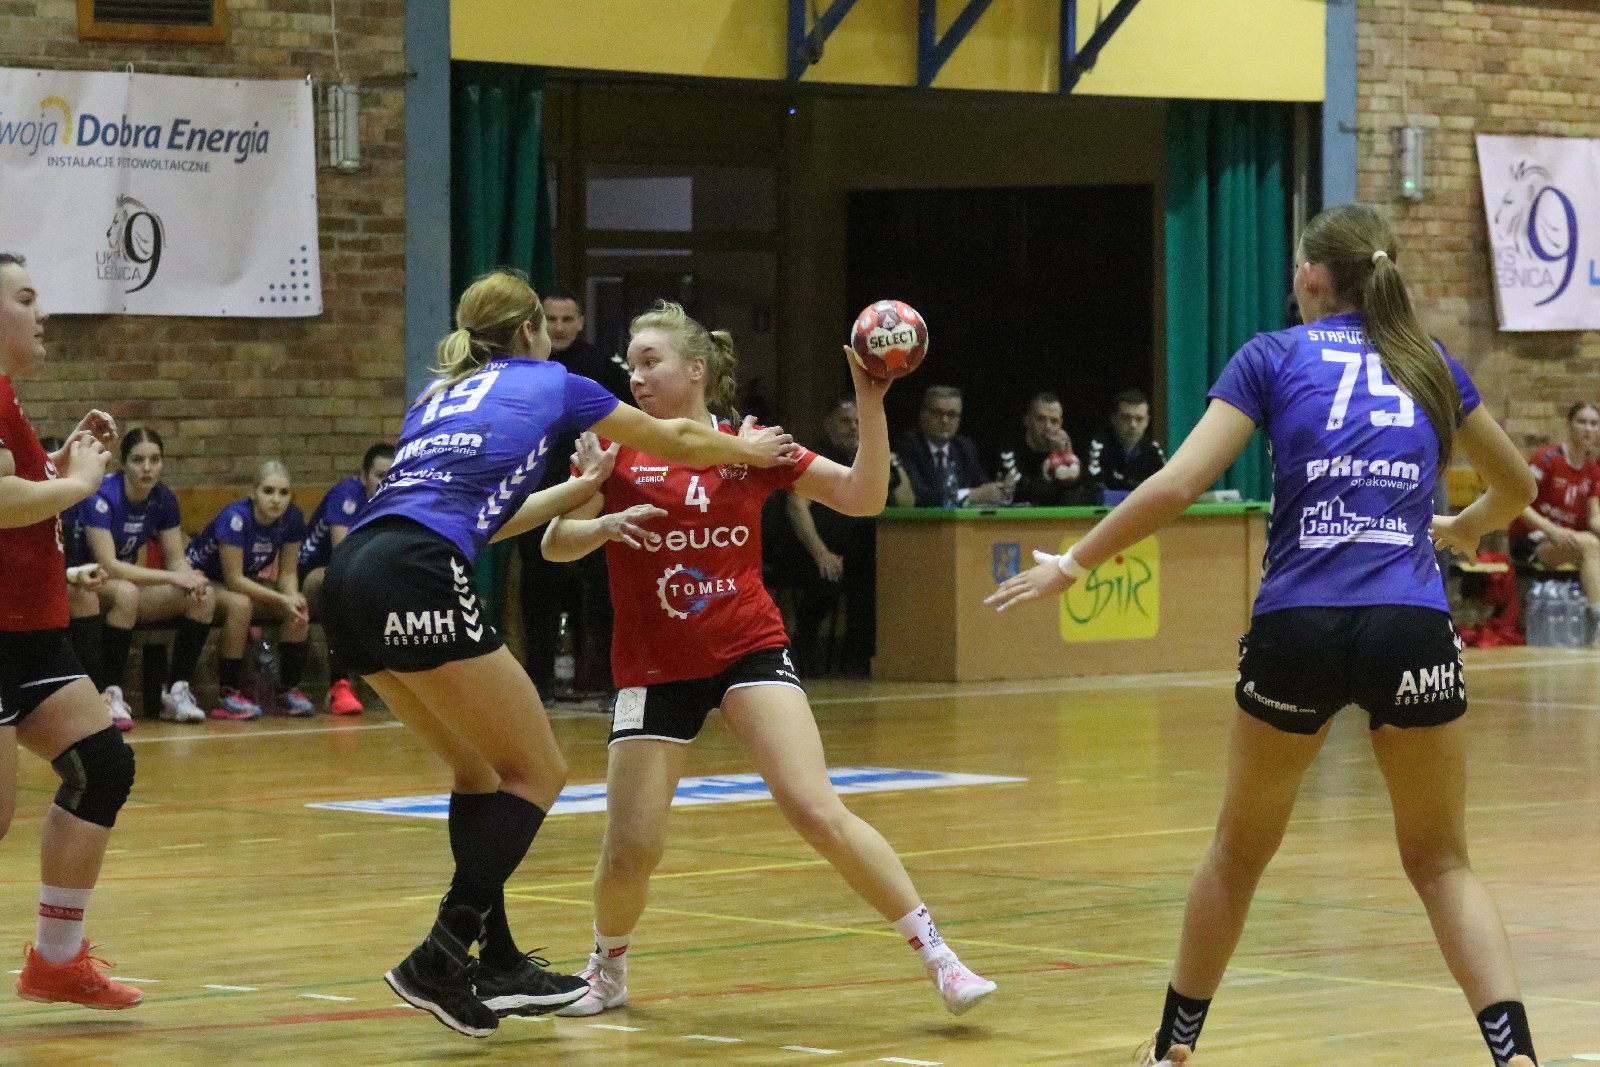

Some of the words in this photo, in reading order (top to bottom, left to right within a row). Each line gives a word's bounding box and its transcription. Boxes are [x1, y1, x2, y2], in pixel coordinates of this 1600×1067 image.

[77, 113, 161, 149] Dobra
[167, 118, 270, 164] Energia
[47, 156, 114, 168] INSTALACJE
[124, 211, 162, 294] 9
[1527, 185, 1578, 307] 9
[869, 329, 914, 349] SELECT
[421, 370, 500, 425] 19
[1321, 348, 1415, 430] 75
[639, 475, 665, 483] LEGNICA
[684, 475, 711, 513] 4
[669, 577, 737, 598] TOMEX
[384, 609, 455, 636] AMH
[384, 634, 409, 646] 365
[413, 632, 457, 645] SPORT
[1396, 661, 1455, 697] AMH
[1394, 694, 1420, 706] 365
[1423, 687, 1454, 704] SPORT
